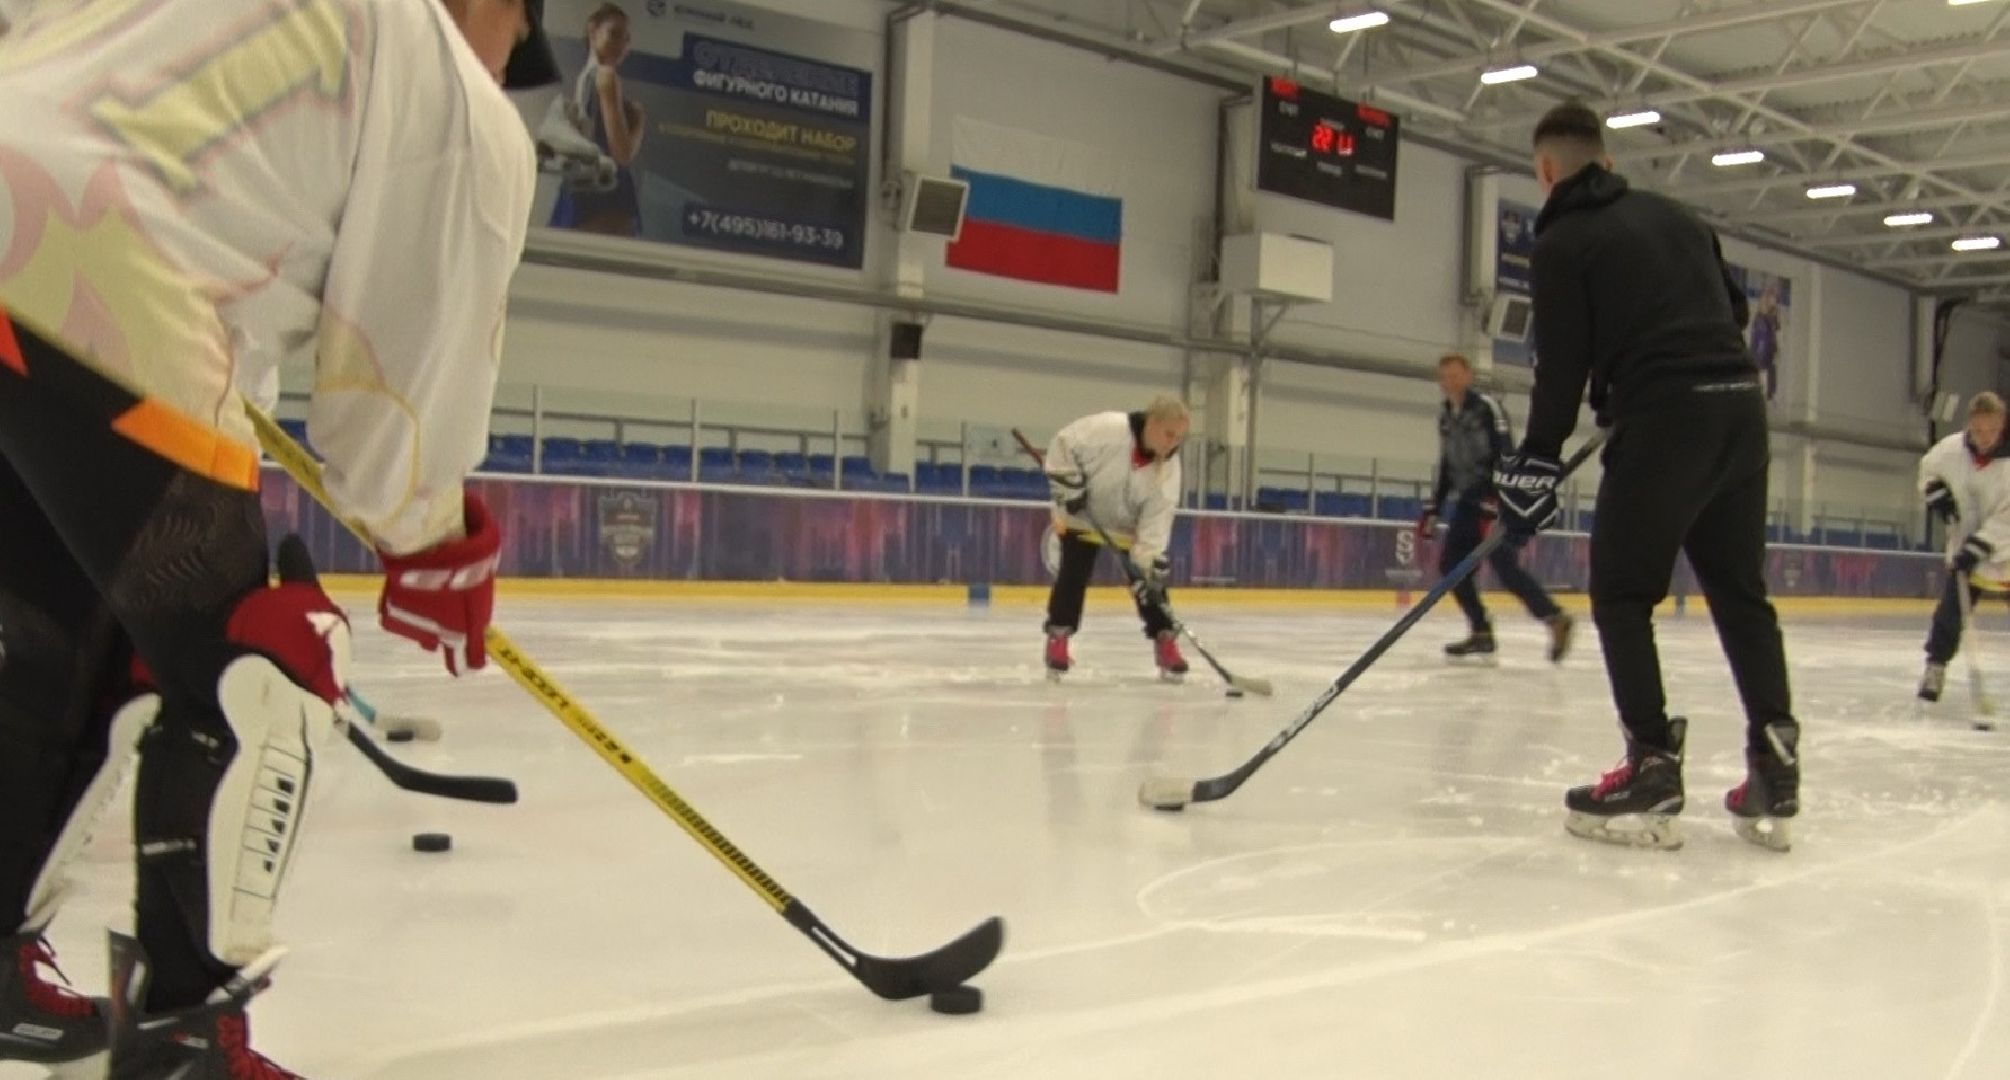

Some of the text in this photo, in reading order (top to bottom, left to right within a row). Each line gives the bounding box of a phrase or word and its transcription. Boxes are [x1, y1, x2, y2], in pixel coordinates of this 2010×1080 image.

[694, 69, 858, 115] ФИГУРНОГО КАТАНИЯ
[705, 109, 799, 145] ПРОХОДИТ
[800, 127, 857, 153] НАБОР
